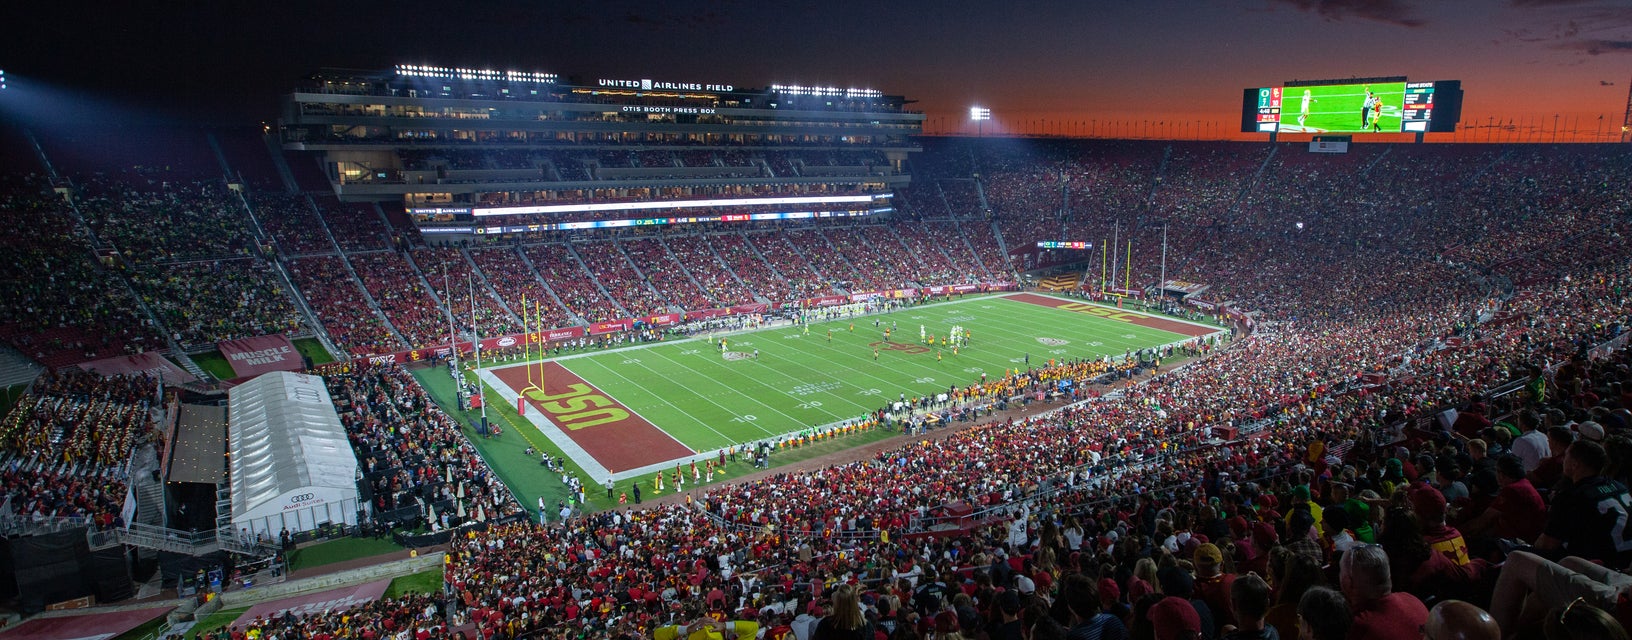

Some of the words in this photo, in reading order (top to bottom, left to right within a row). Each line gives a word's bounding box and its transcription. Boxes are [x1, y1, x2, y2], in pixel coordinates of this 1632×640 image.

[599, 79, 640, 88] UNITED
[653, 81, 702, 90] AIRLINES
[706, 84, 733, 92] FIELD
[1057, 303, 1149, 322] USC
[230, 345, 292, 361] MUSCLE
[246, 355, 285, 365] MILK
[526, 383, 630, 431] USC
